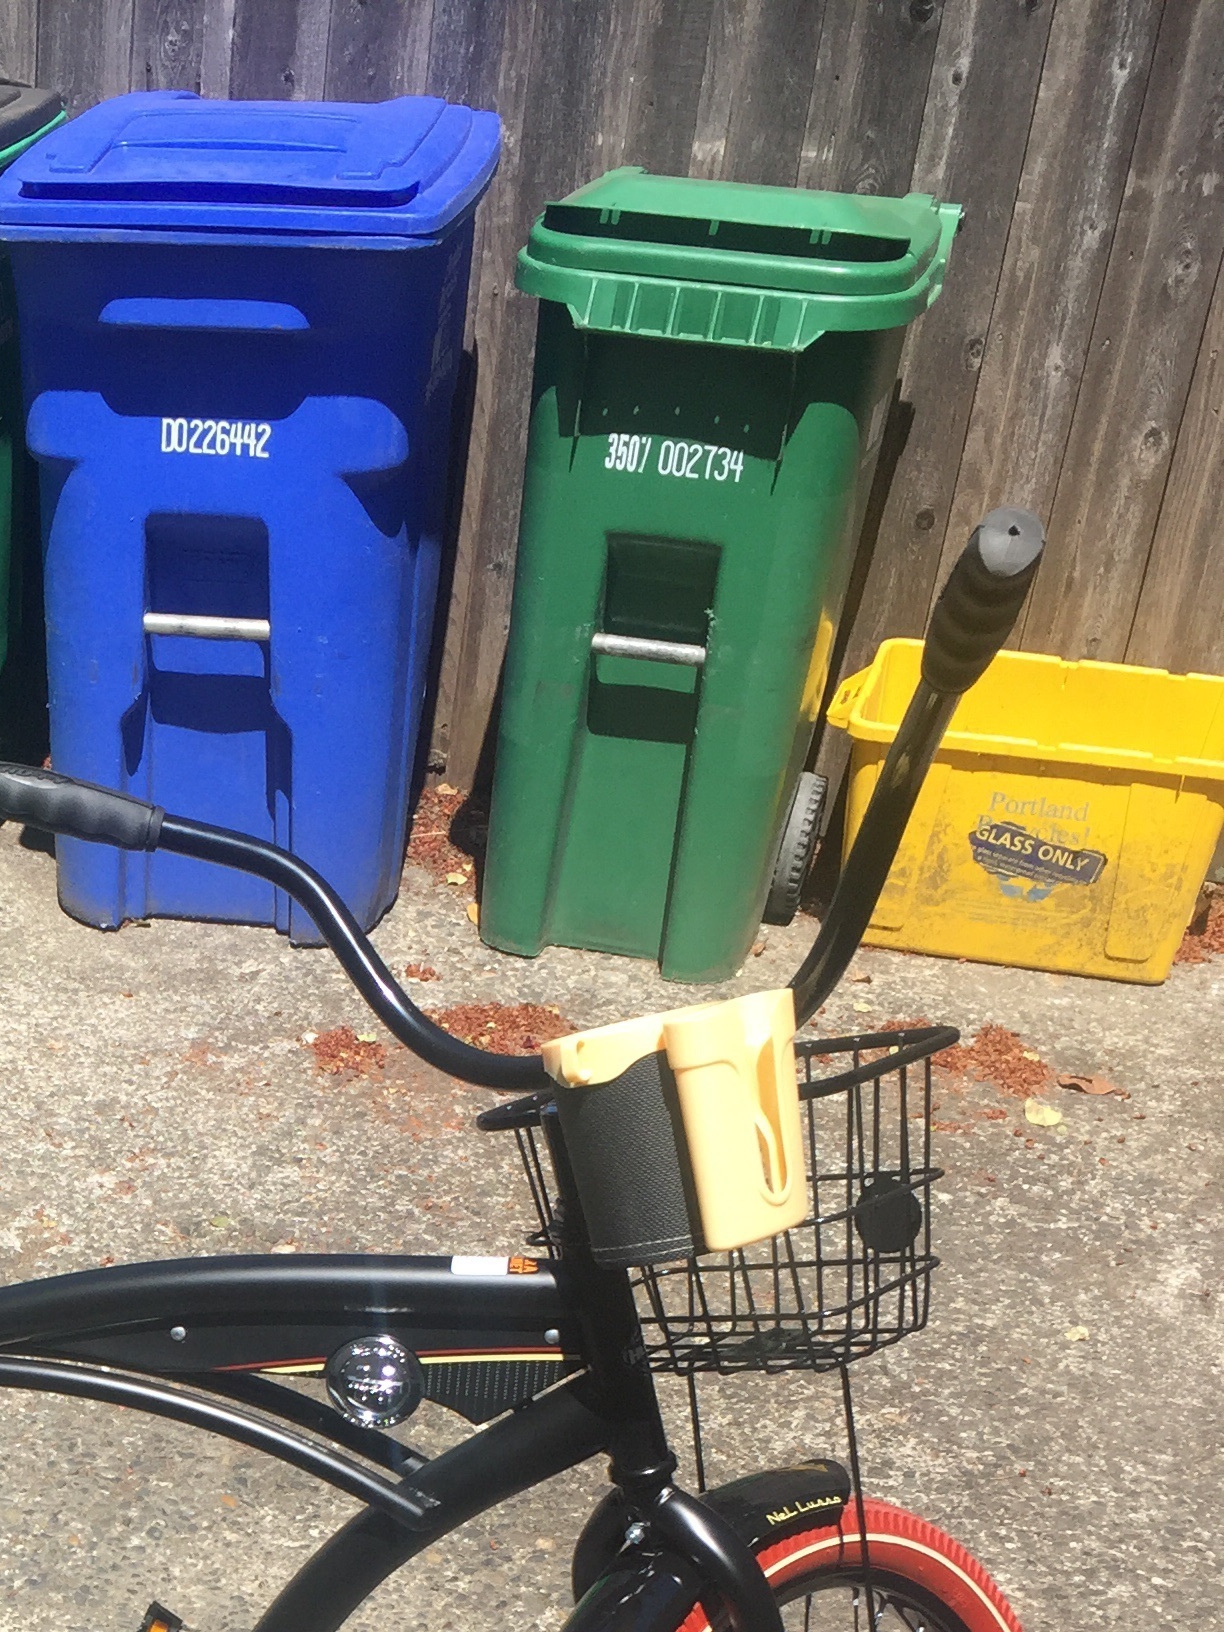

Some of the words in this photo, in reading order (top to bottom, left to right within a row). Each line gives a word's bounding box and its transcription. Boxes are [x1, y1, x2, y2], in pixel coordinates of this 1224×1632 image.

[658, 440, 744, 483] 002734
[988, 791, 1090, 822] Portland
[976, 825, 1035, 855] GLASS
[1037, 845, 1090, 872] ONLY
